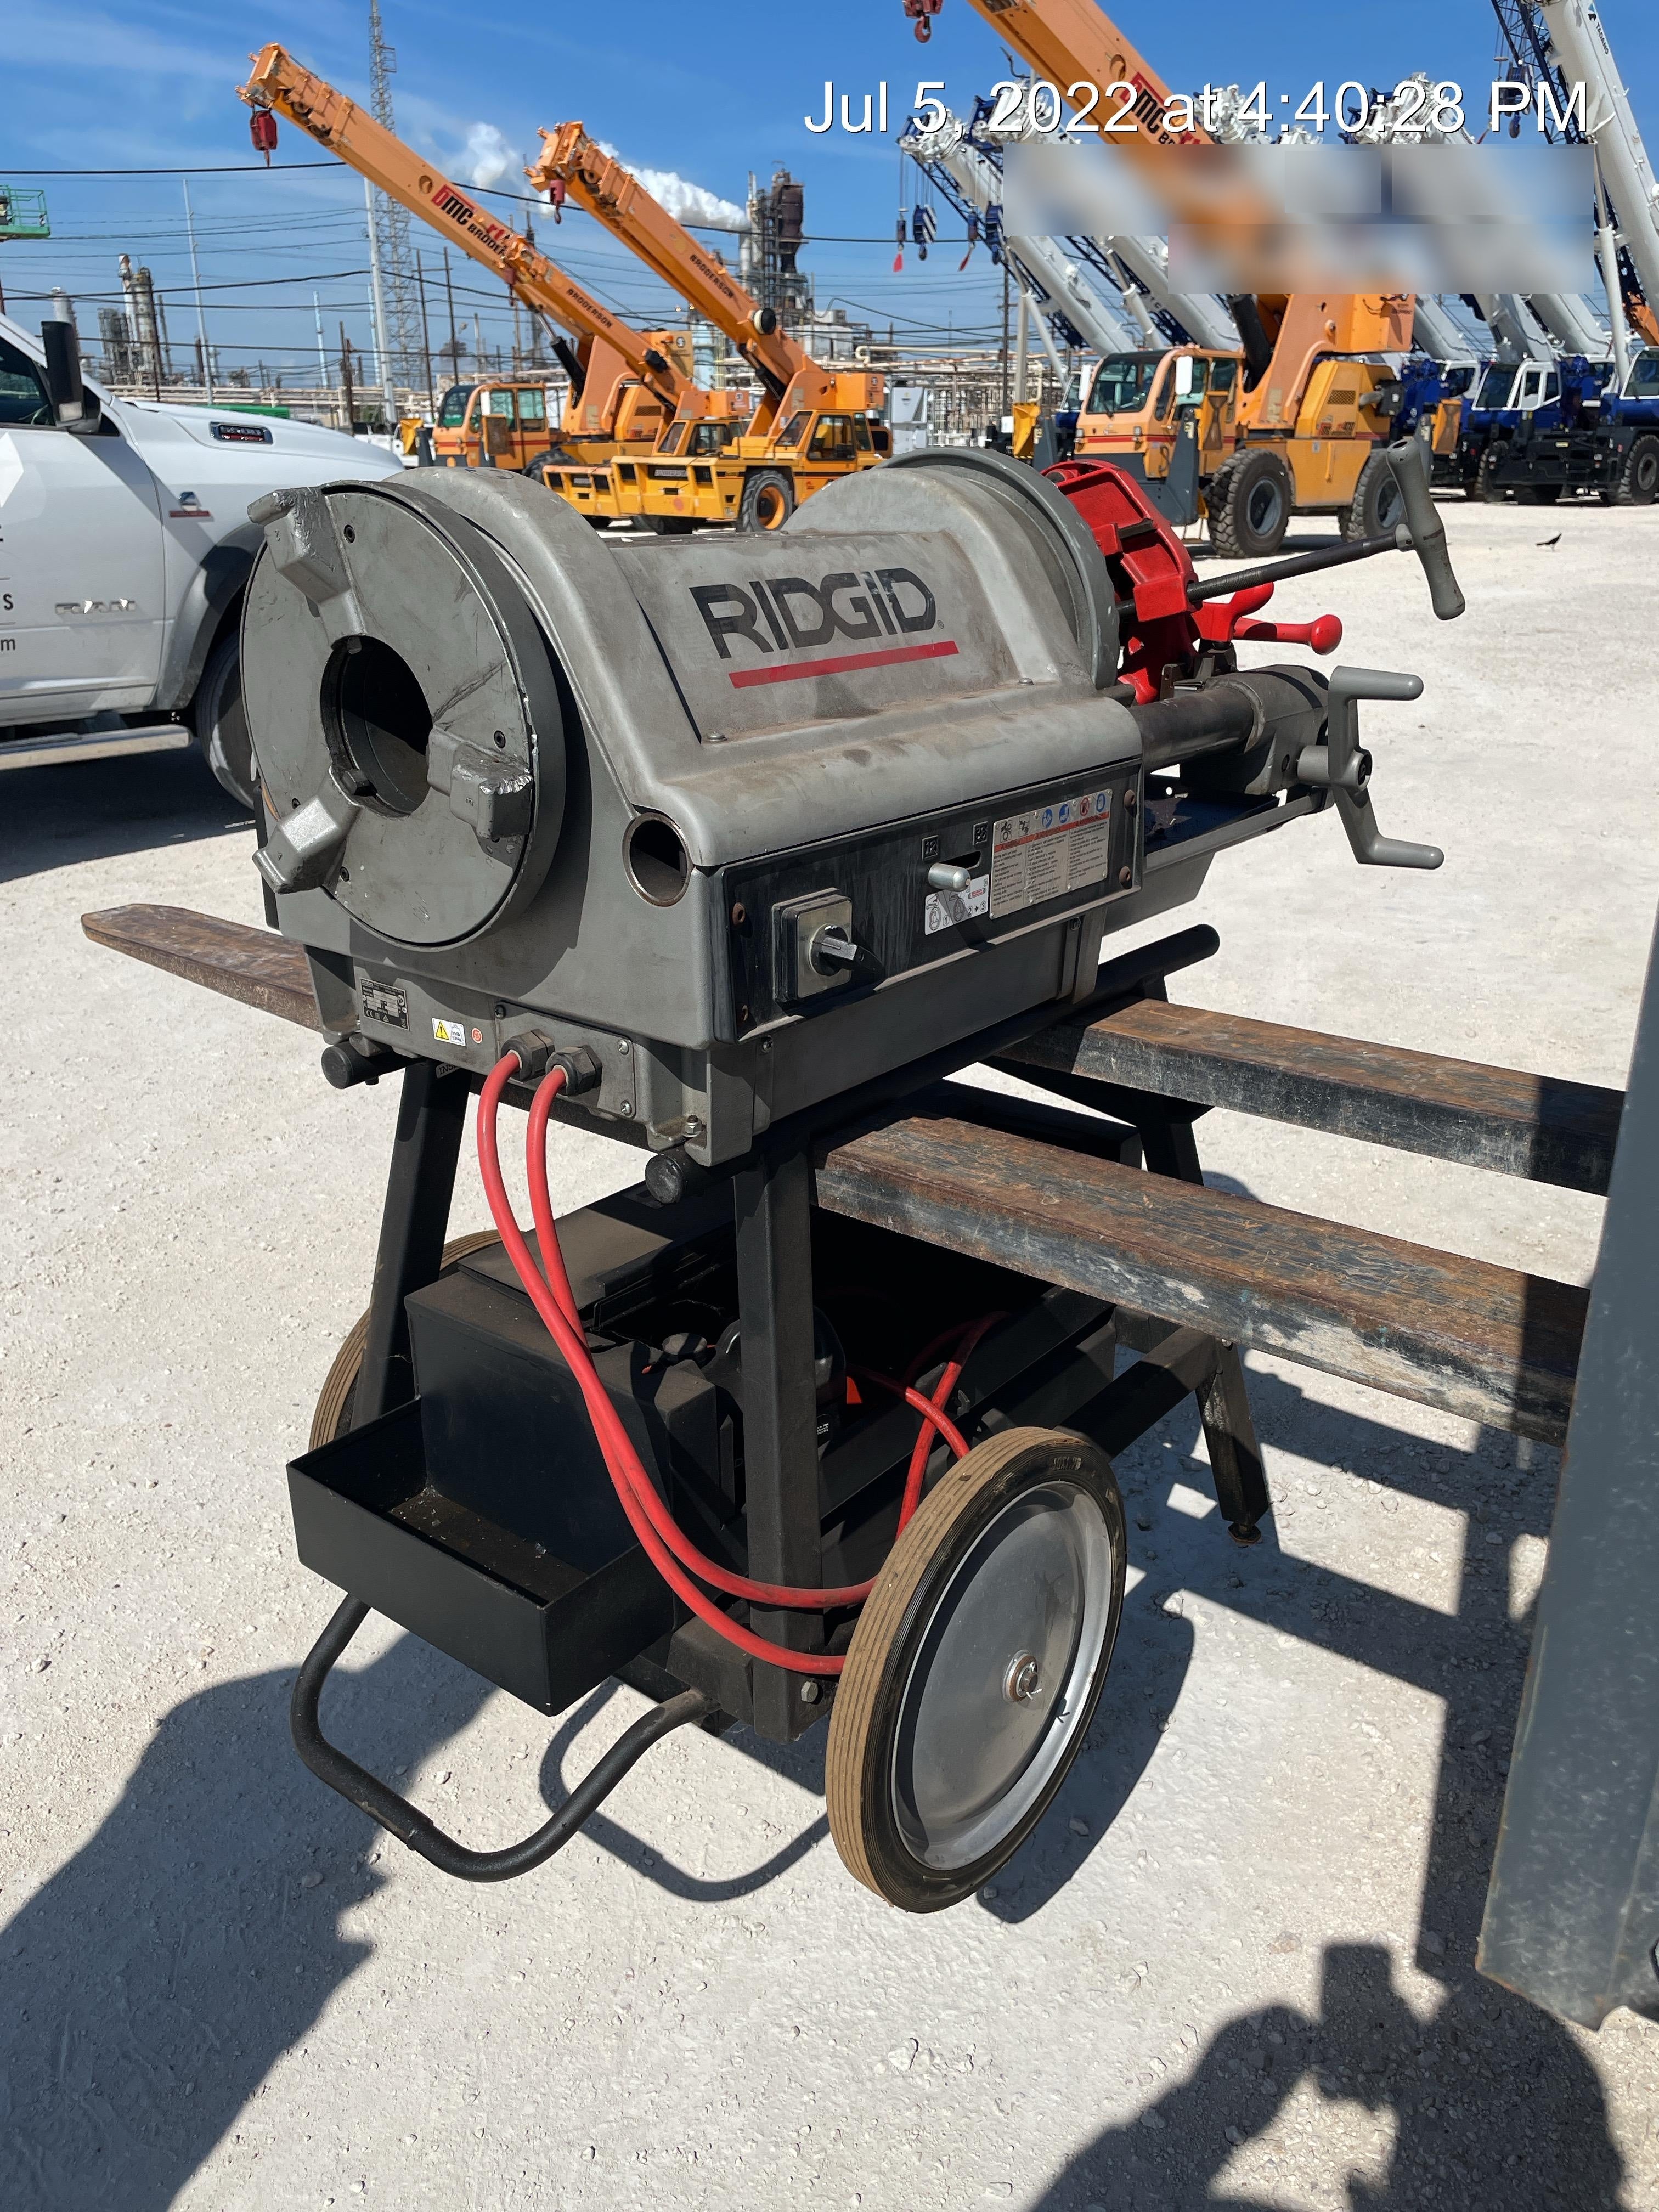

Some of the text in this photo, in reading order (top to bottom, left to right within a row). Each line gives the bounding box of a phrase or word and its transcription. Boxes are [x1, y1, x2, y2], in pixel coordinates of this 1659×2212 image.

[1595, 22, 1609, 55] TADANO
[690, 253, 734, 299] BRODERSON
[566, 287, 613, 329] BRODERSON
[689, 568, 937, 659] RIDGID
